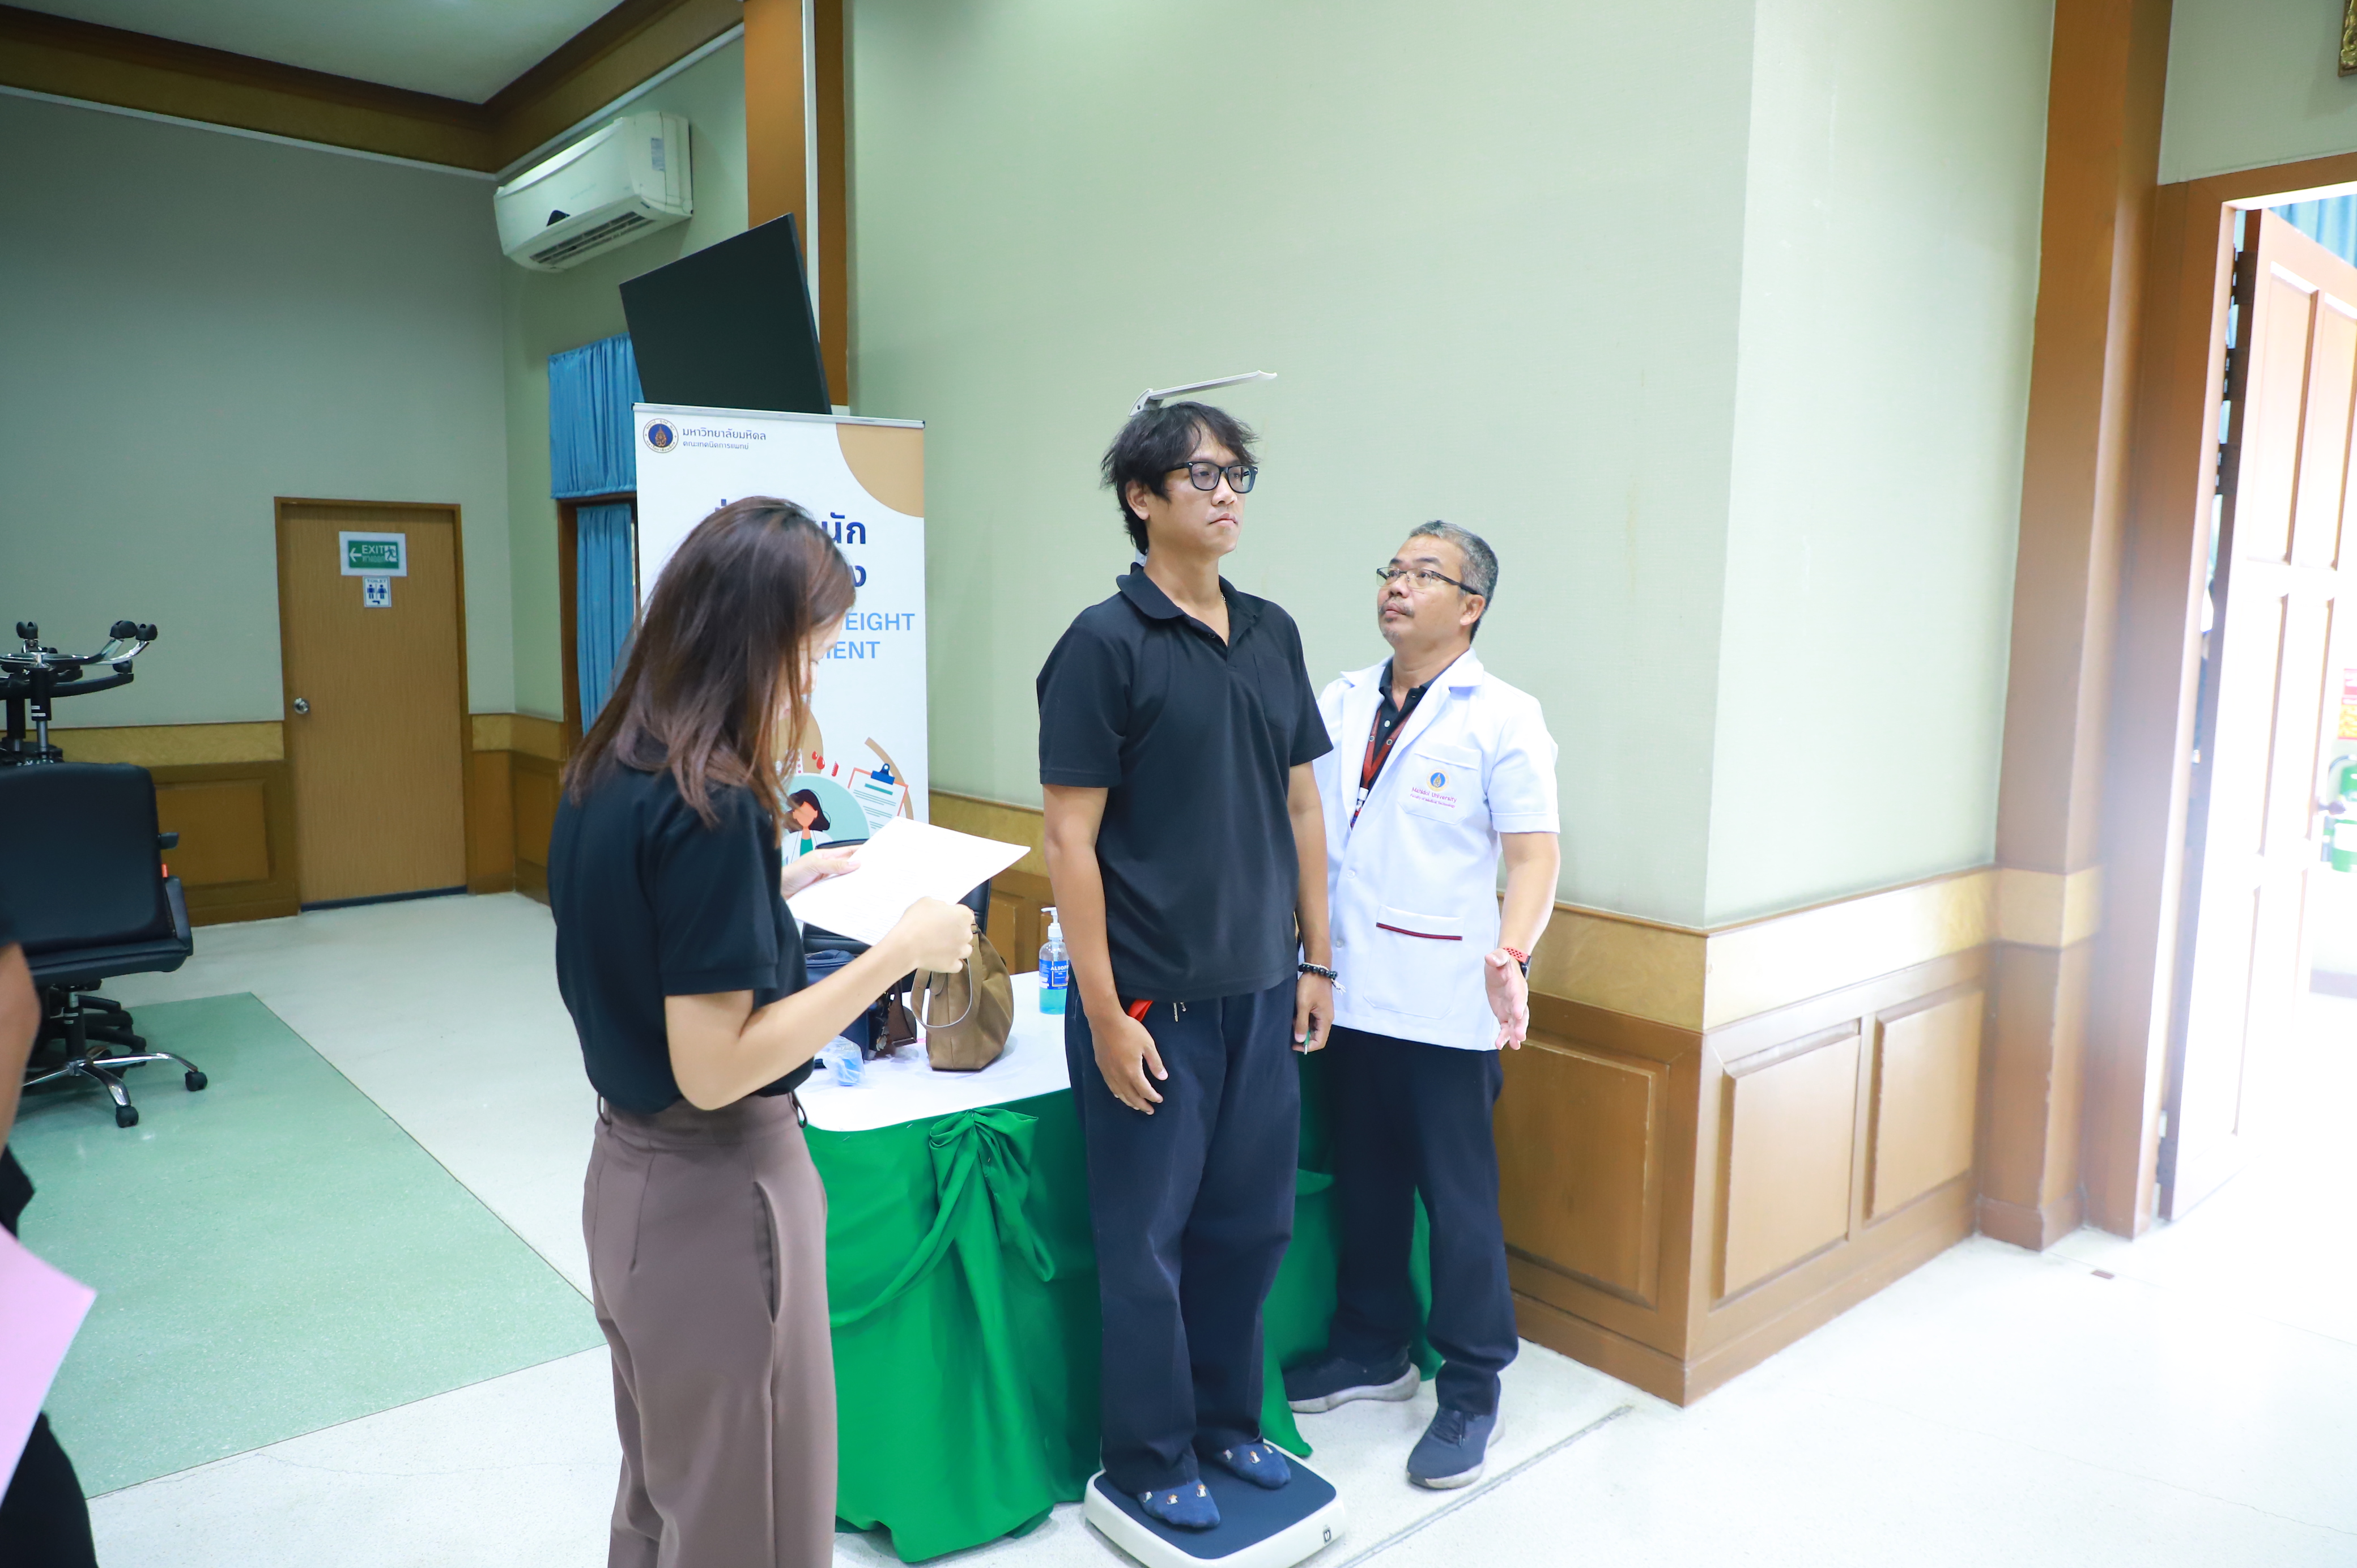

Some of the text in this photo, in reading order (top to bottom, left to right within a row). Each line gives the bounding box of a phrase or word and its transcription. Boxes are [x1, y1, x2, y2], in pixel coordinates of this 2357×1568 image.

[682, 427, 766, 440] มหาวิทยาลัยมหิดล
[683, 440, 749, 450] คณะเทคนิคการแพทย์
[361, 544, 384, 554] EXIT
[845, 612, 915, 630] EIGHT
[1411, 787, 1457, 803] Mahidol University
